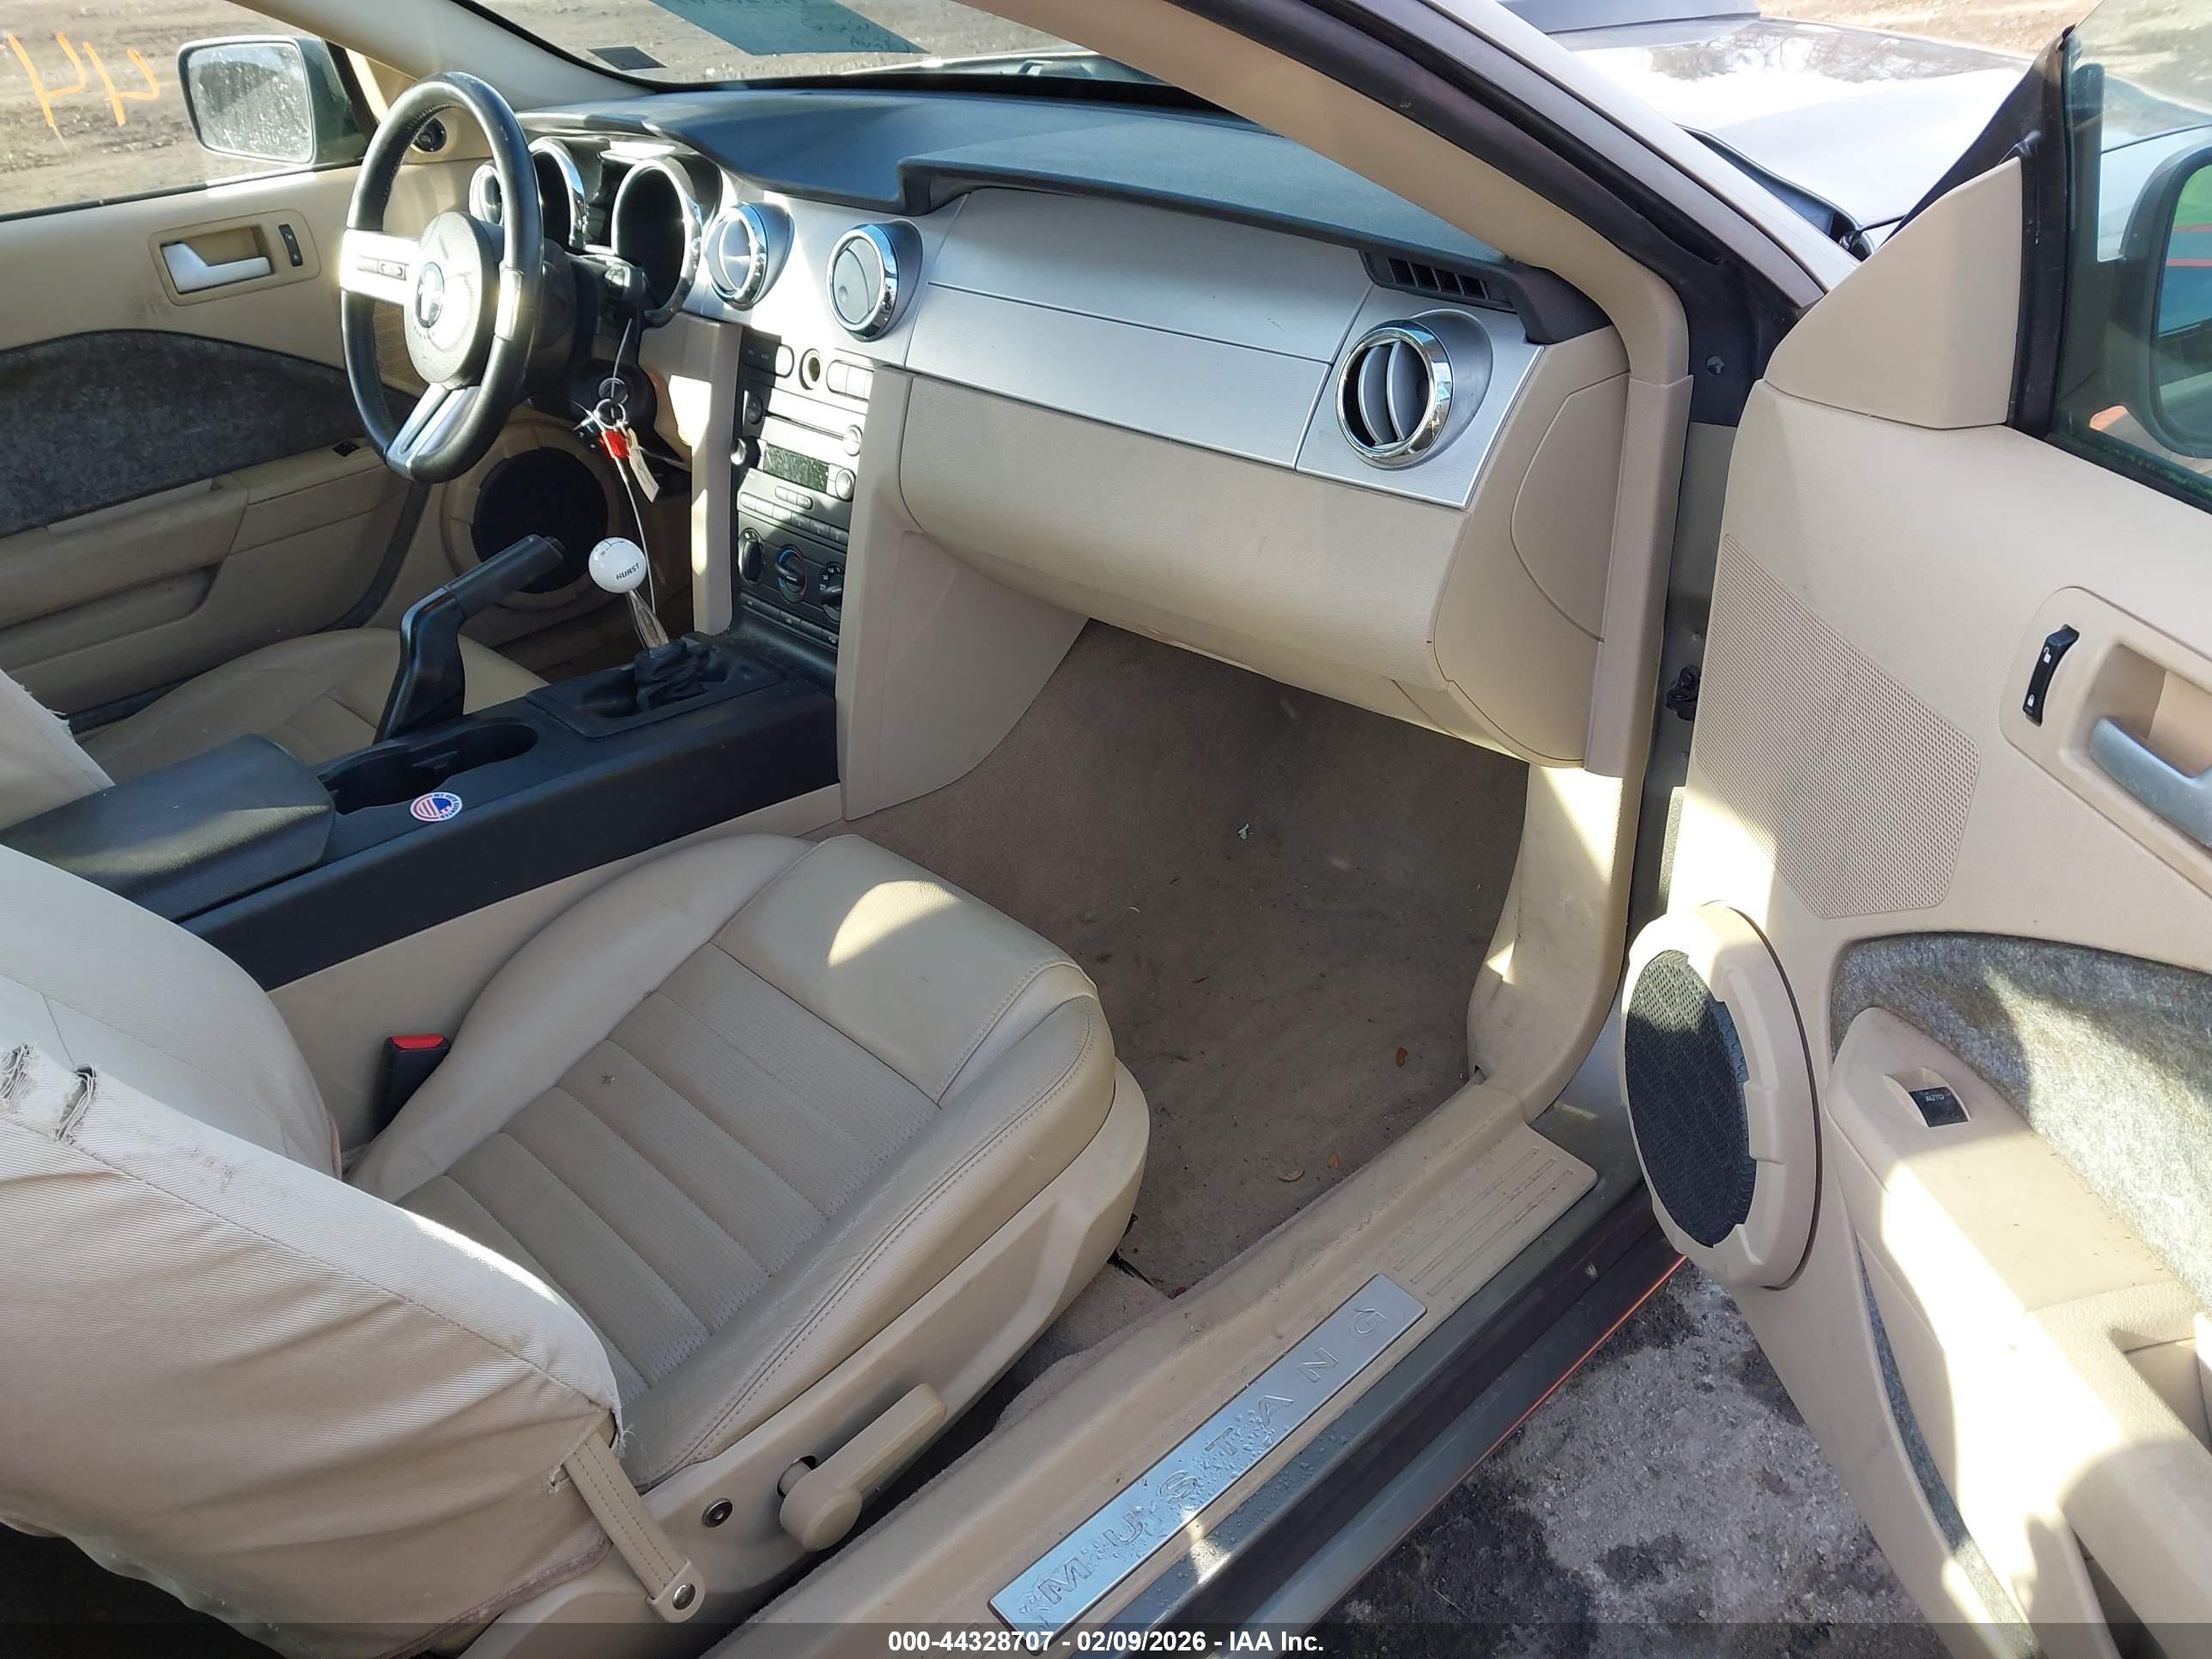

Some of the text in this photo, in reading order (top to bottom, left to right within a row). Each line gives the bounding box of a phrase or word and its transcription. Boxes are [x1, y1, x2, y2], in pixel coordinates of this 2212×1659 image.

[616, 562, 640, 580] HURST
[1925, 1093, 1945, 1102] AUTO
[1037, 1307, 1388, 1606] MUSTANG
